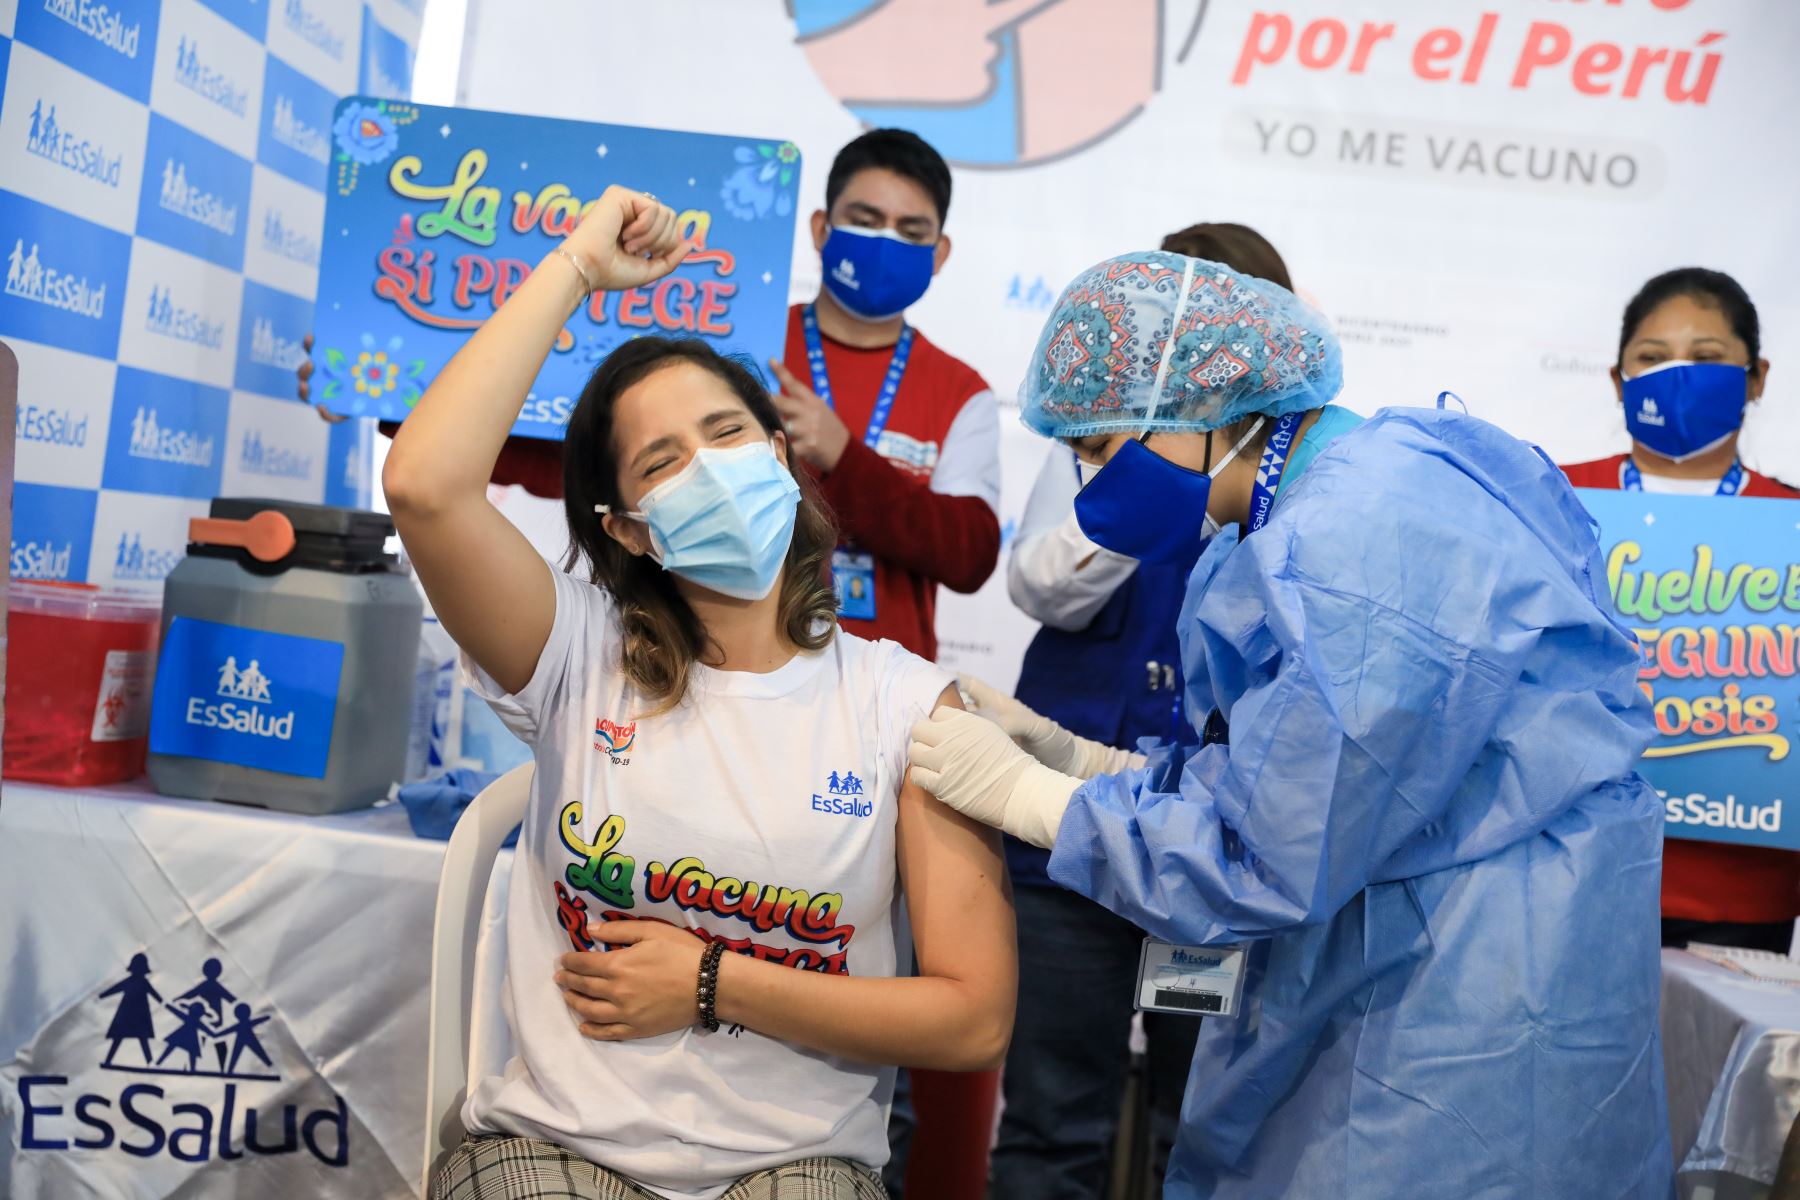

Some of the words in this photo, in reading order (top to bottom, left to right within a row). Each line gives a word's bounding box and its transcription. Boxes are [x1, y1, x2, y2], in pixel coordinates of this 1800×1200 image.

[77, 0, 140, 59] EsSalud
[1230, 10, 1394, 87] por
[1411, 12, 1501, 84] el
[1510, 20, 1727, 106] Perú
[61, 130, 122, 187] EsSalud
[1254, 119, 1318, 158] YO
[1338, 129, 1408, 167] ME
[1426, 137, 1639, 188] VACUNO
[390, 149, 501, 246] La
[513, 183, 735, 276] vaa
[44, 268, 106, 319] EsSalud
[24, 405, 88, 447] EsSalud
[10, 541, 71, 580] sSalud
[186, 697, 294, 741] EsSalud
[811, 794, 873, 818] EsSalud
[558, 801, 635, 910] La
[645, 857, 855, 950] vacuna
[18, 1074, 349, 1168] EsSalud
